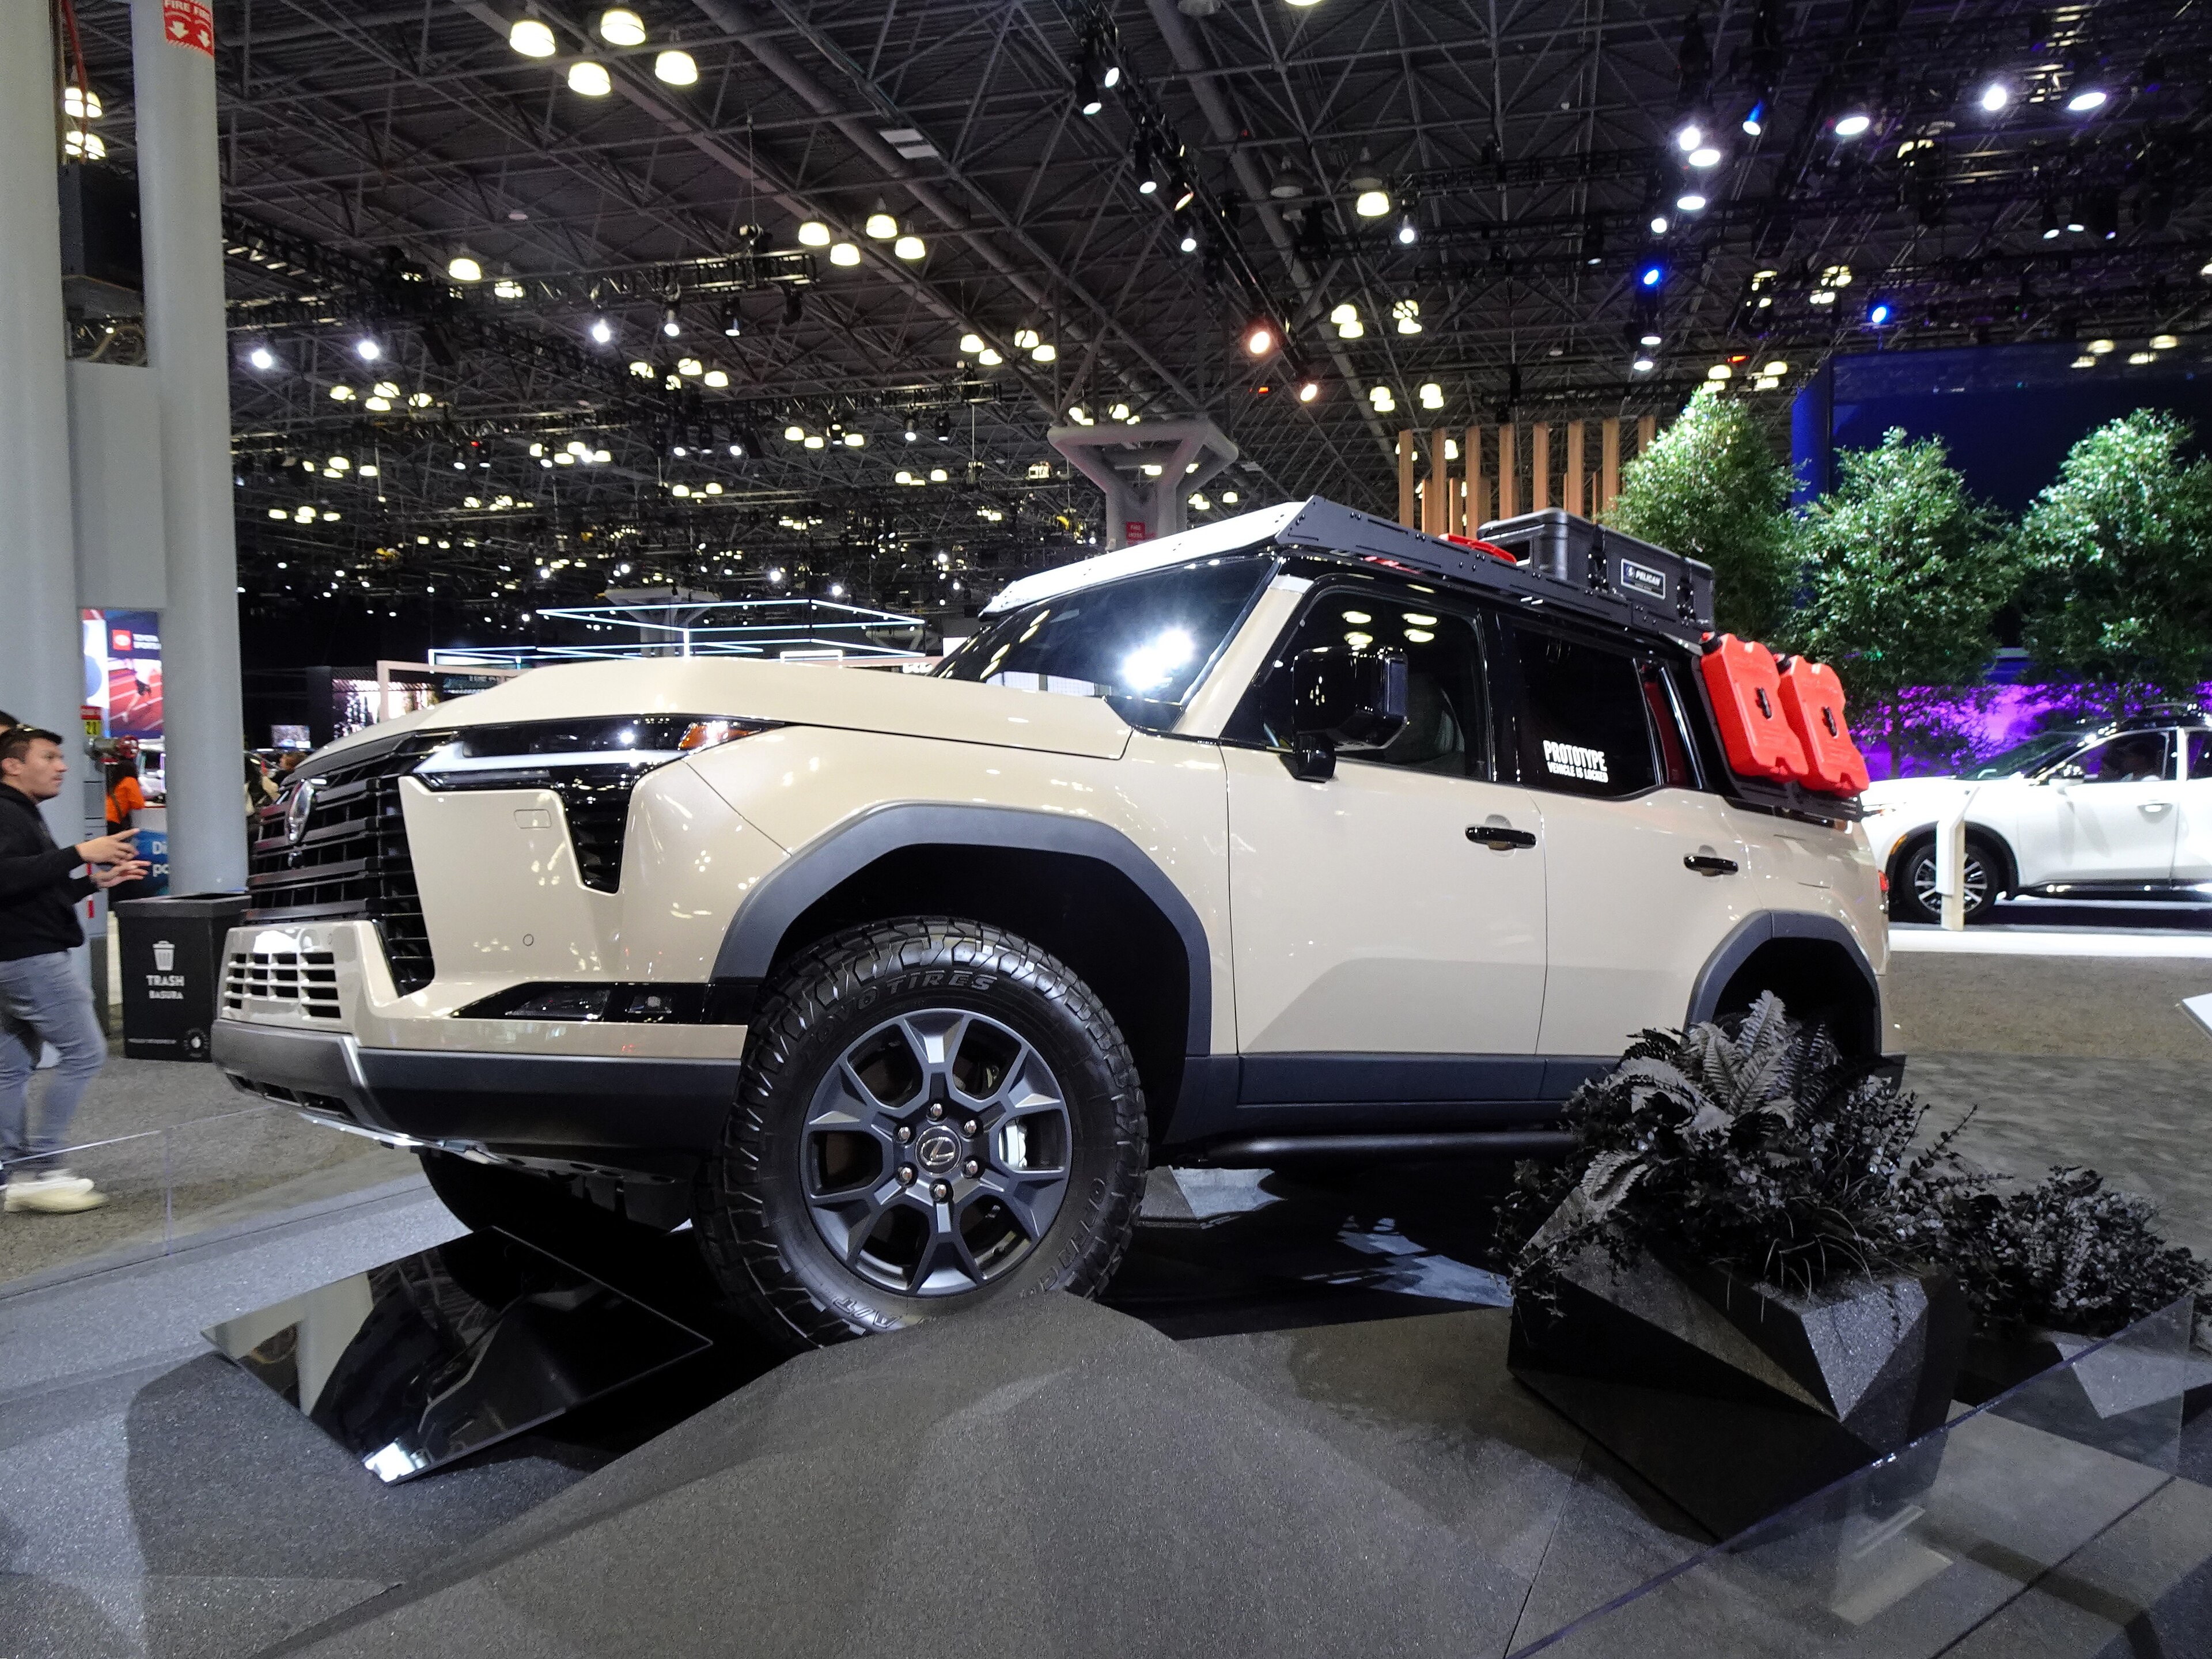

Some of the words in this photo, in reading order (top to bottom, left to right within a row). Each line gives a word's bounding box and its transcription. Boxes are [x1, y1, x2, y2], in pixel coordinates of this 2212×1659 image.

[164, 0, 191, 13] FIRE
[1636, 570, 1661, 587] PELICAN
[1543, 740, 1607, 771] PROTOTYPE
[1547, 761, 1575, 777] VEHICLE
[1575, 767, 1584, 778] IS
[1584, 768, 1608, 783] LOCKED
[146, 975, 184, 987] TRASH
[886, 970, 998, 995] TIRES
